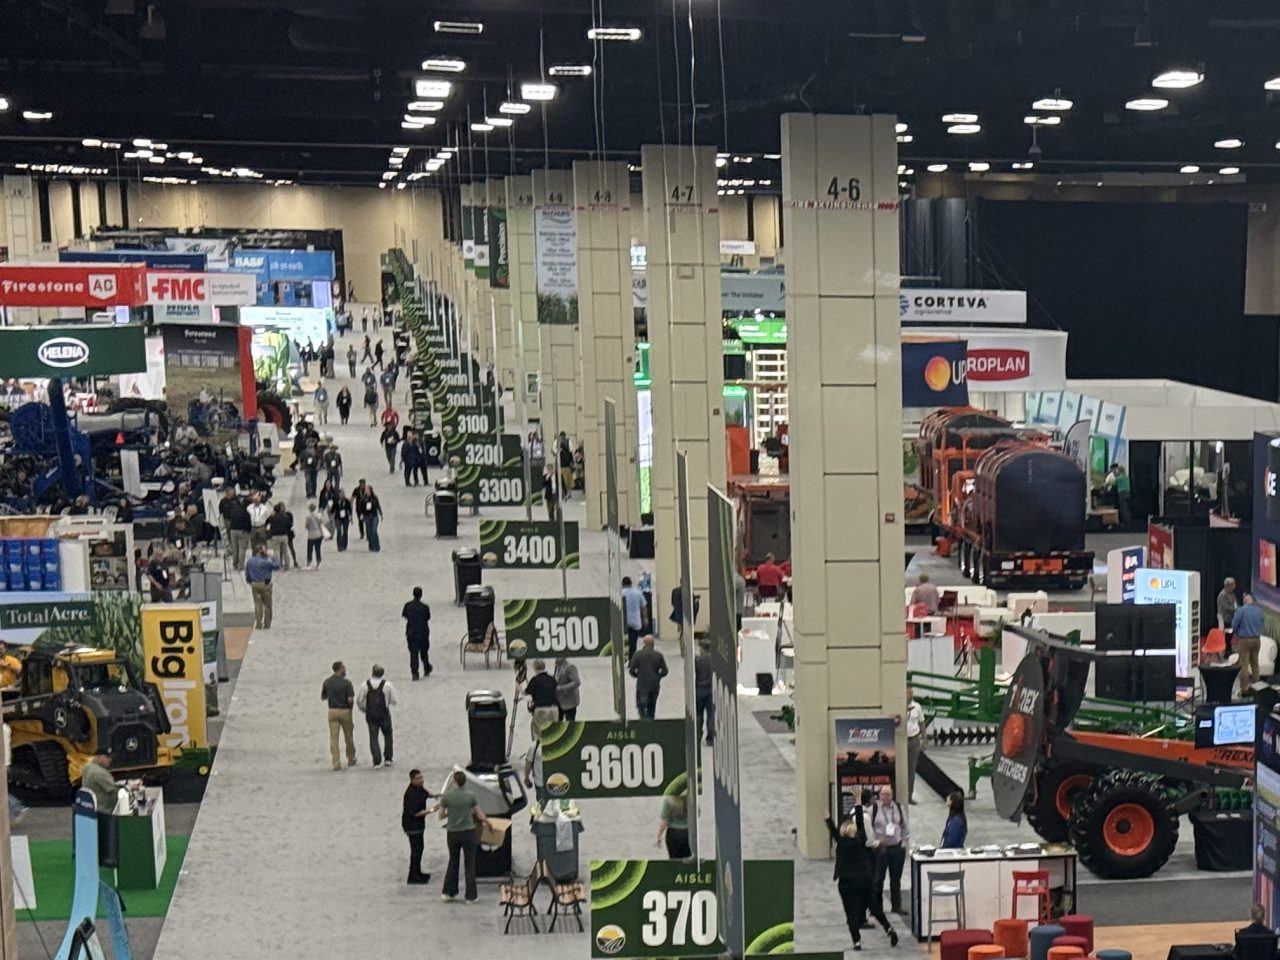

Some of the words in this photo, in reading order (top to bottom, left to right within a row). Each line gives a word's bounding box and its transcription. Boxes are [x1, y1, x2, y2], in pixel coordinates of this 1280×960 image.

[672, 186, 694, 201] 4-7
[828, 177, 860, 200] 4-6
[2, 280, 84, 294] Firestone
[152, 279, 205, 300] FMC
[914, 296, 987, 309] CORTEVA
[43, 346, 84, 360] HELENA
[458, 415, 488, 434] 3100
[465, 444, 503, 466] 3200
[479, 478, 522, 503] 3300
[504, 535, 556, 564] 3400
[535, 615, 599, 652] 3500
[607, 730, 636, 740] AISLE
[580, 743, 664, 789] 3600
[675, 872, 712, 884] AISLE
[642, 889, 726, 947] 370
